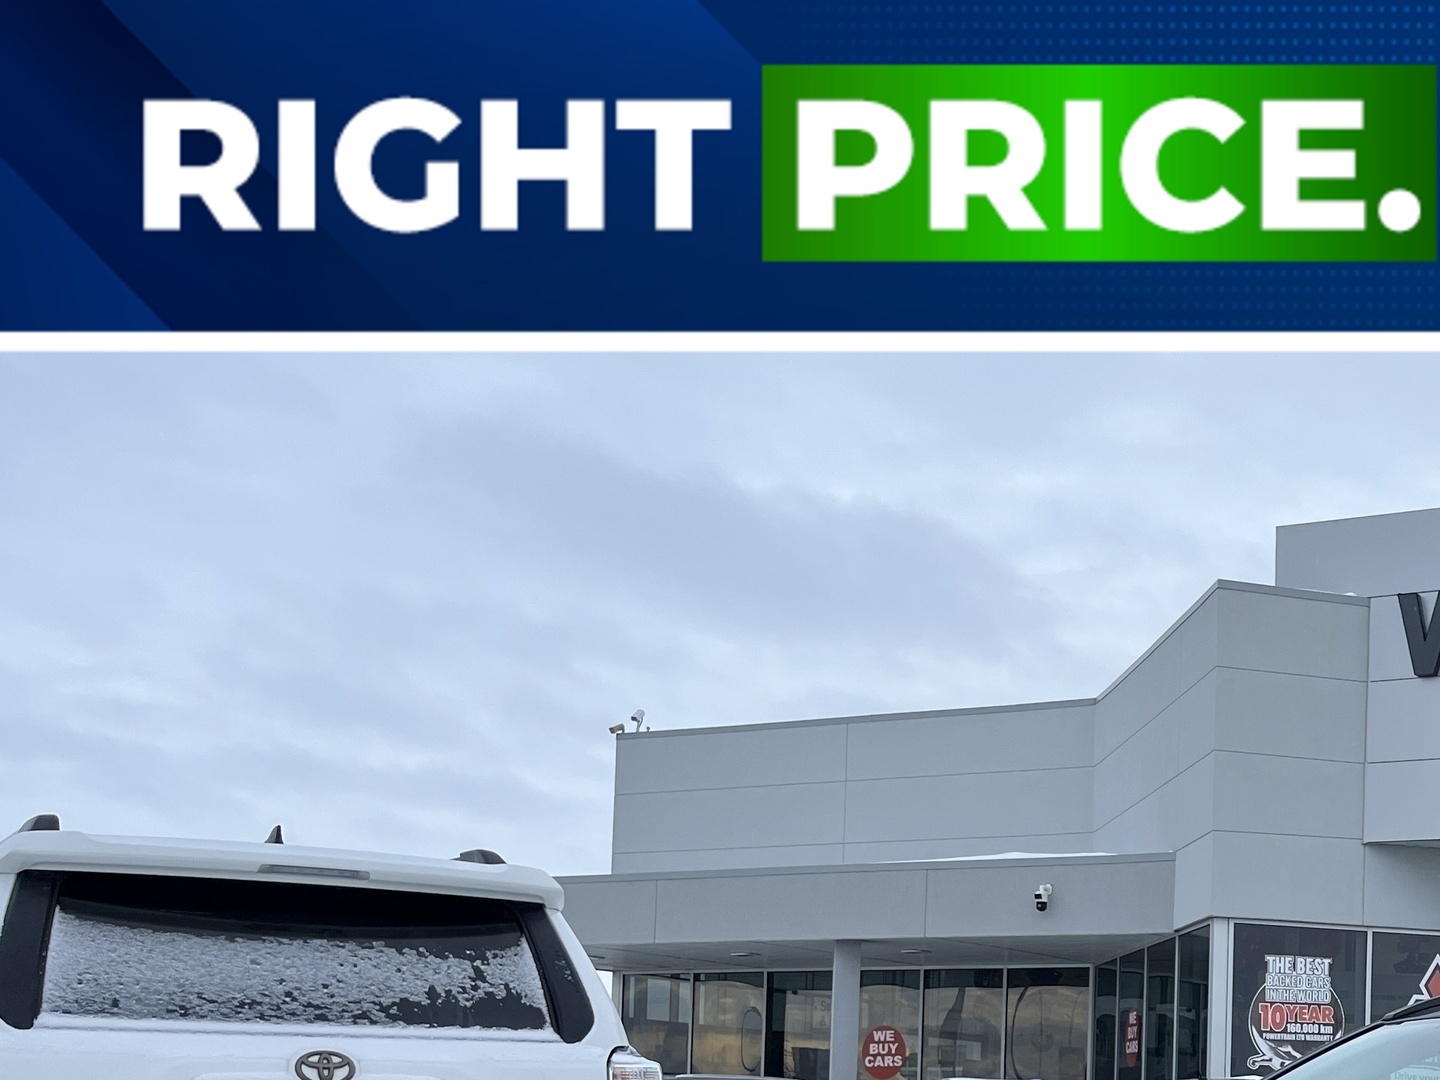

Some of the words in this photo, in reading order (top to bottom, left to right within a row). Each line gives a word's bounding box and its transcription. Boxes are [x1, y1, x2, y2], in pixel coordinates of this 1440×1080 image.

[1266, 956, 1294, 974] THE
[1297, 957, 1332, 975] BEST
[1266, 975, 1305, 988] BACKED
[1305, 976, 1331, 989] CARS
[1266, 988, 1276, 1001] IN
[1277, 989, 1296, 1002] THE
[1298, 989, 1331, 1003] WORLD
[1259, 1003, 1287, 1032] 10
[1285, 1004, 1334, 1023] YEAR
[873, 1030, 895, 1042] WE
[1320, 1025, 1333, 1034] km
[869, 1043, 899, 1055] BUY
[1126, 1040, 1139, 1053] CARS
[864, 1055, 903, 1068] CARS
[1394, 1072, 1418, 1080] Drive
